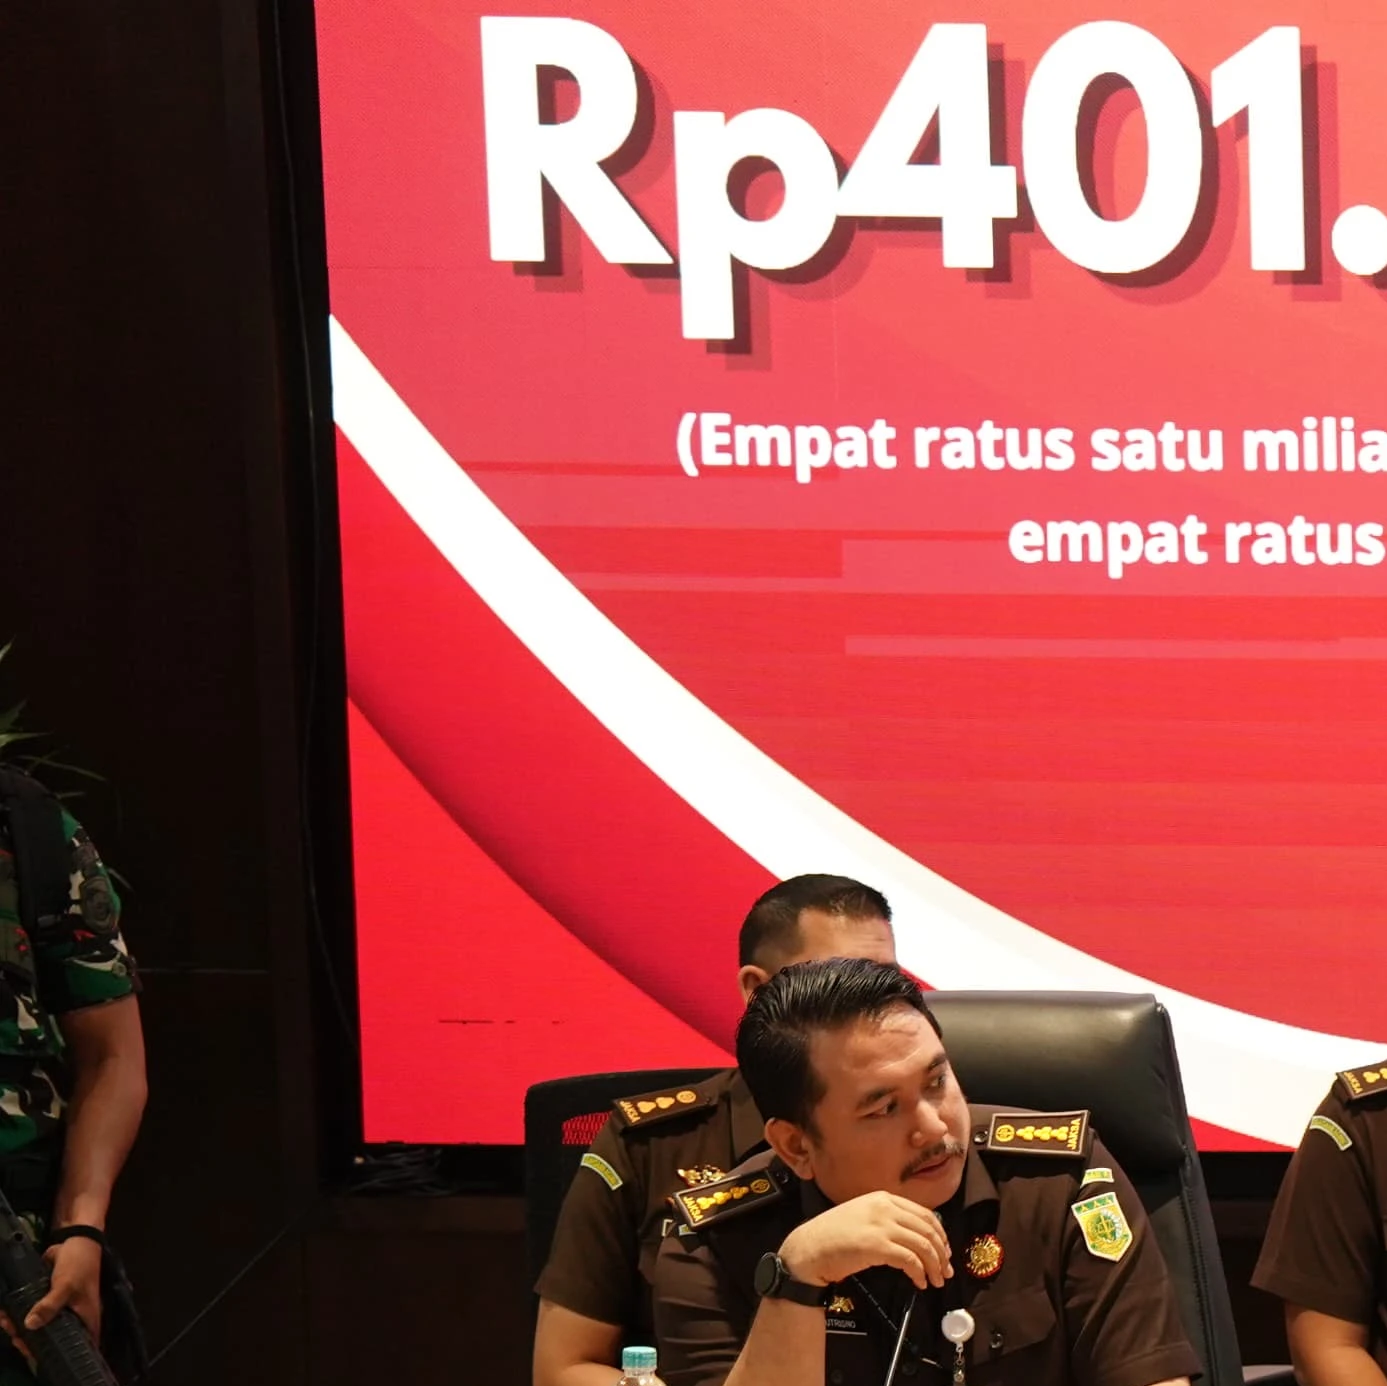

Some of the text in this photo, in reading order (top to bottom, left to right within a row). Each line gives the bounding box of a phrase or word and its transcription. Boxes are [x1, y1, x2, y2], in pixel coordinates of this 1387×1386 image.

[677, 412, 897, 484] (Empat
[914, 420, 1075, 471] ratus
[1091, 421, 1224, 472] satu
[1008, 515, 1208, 579] empat
[1225, 515, 1386, 566] ratus
